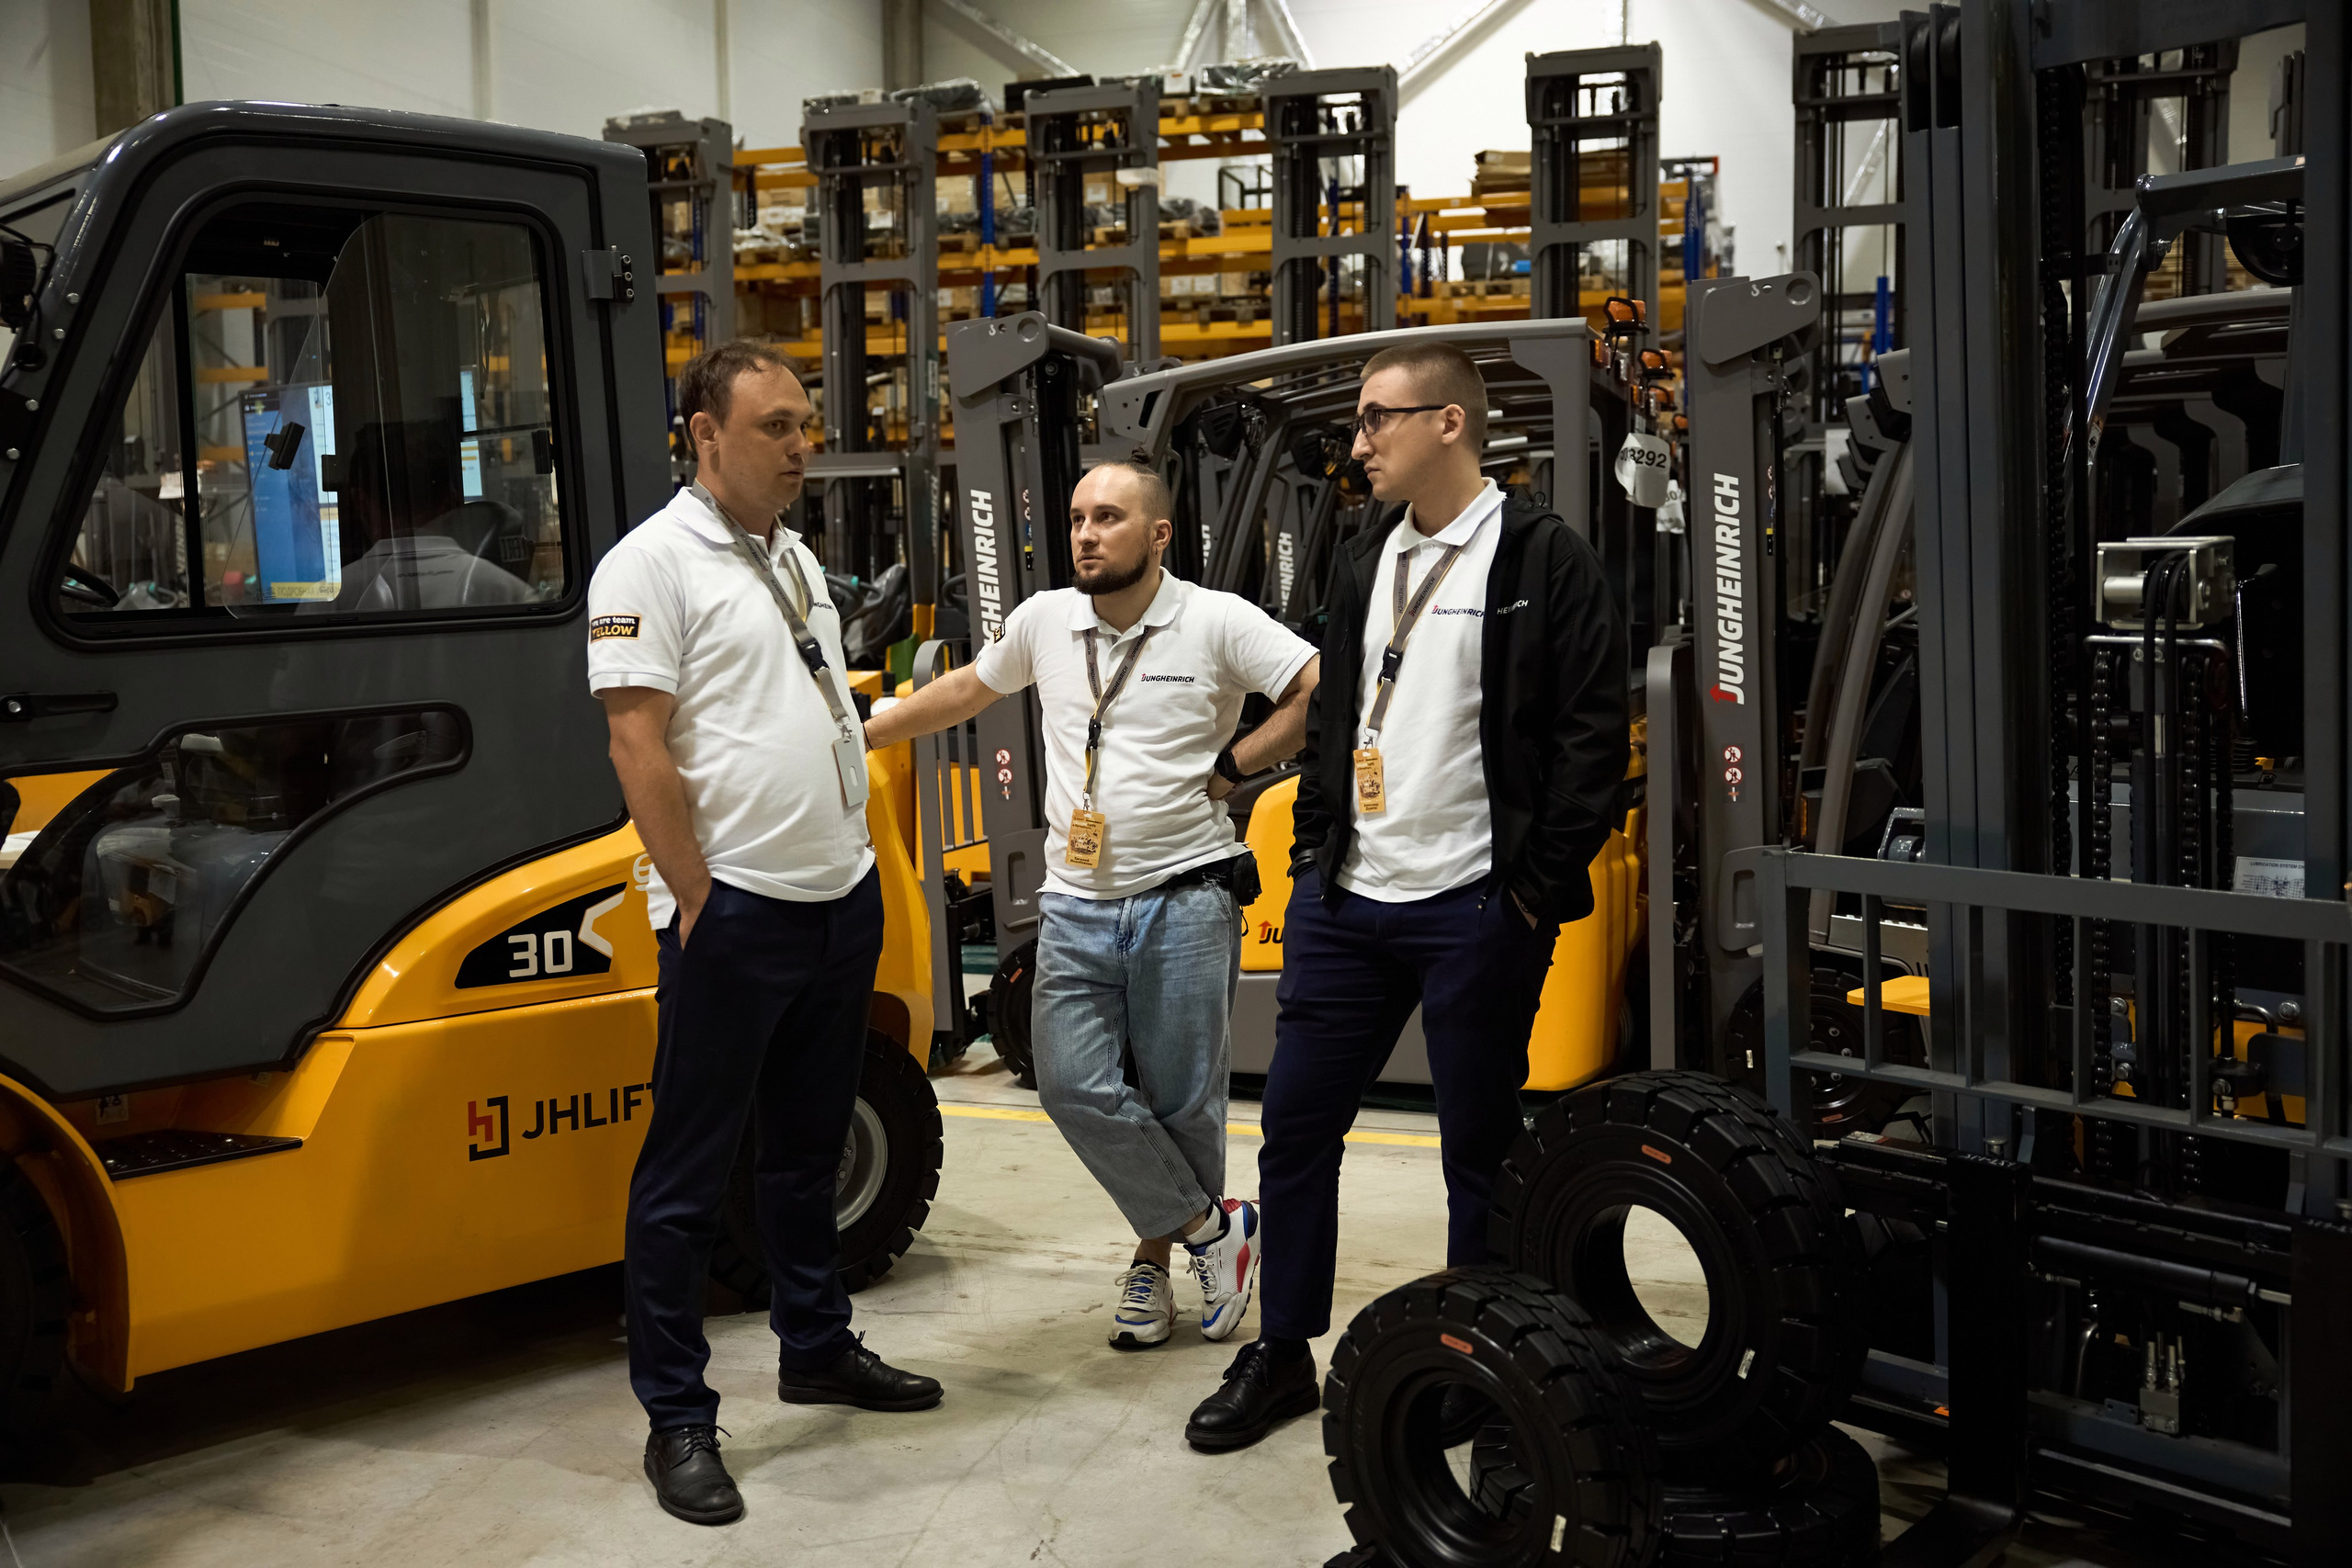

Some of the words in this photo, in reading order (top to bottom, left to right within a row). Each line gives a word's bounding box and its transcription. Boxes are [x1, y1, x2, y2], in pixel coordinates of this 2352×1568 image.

[1408, 576, 1436, 617] JUNGHEINRICH
[1711, 472, 1745, 705] JUNGHEINRICH
[612, 616, 636, 625] team
[1106, 665, 1128, 701] JUNGHEINRICH
[1140, 673, 1195, 683] JUNGHEINRICH
[508, 930, 573, 978] 30
